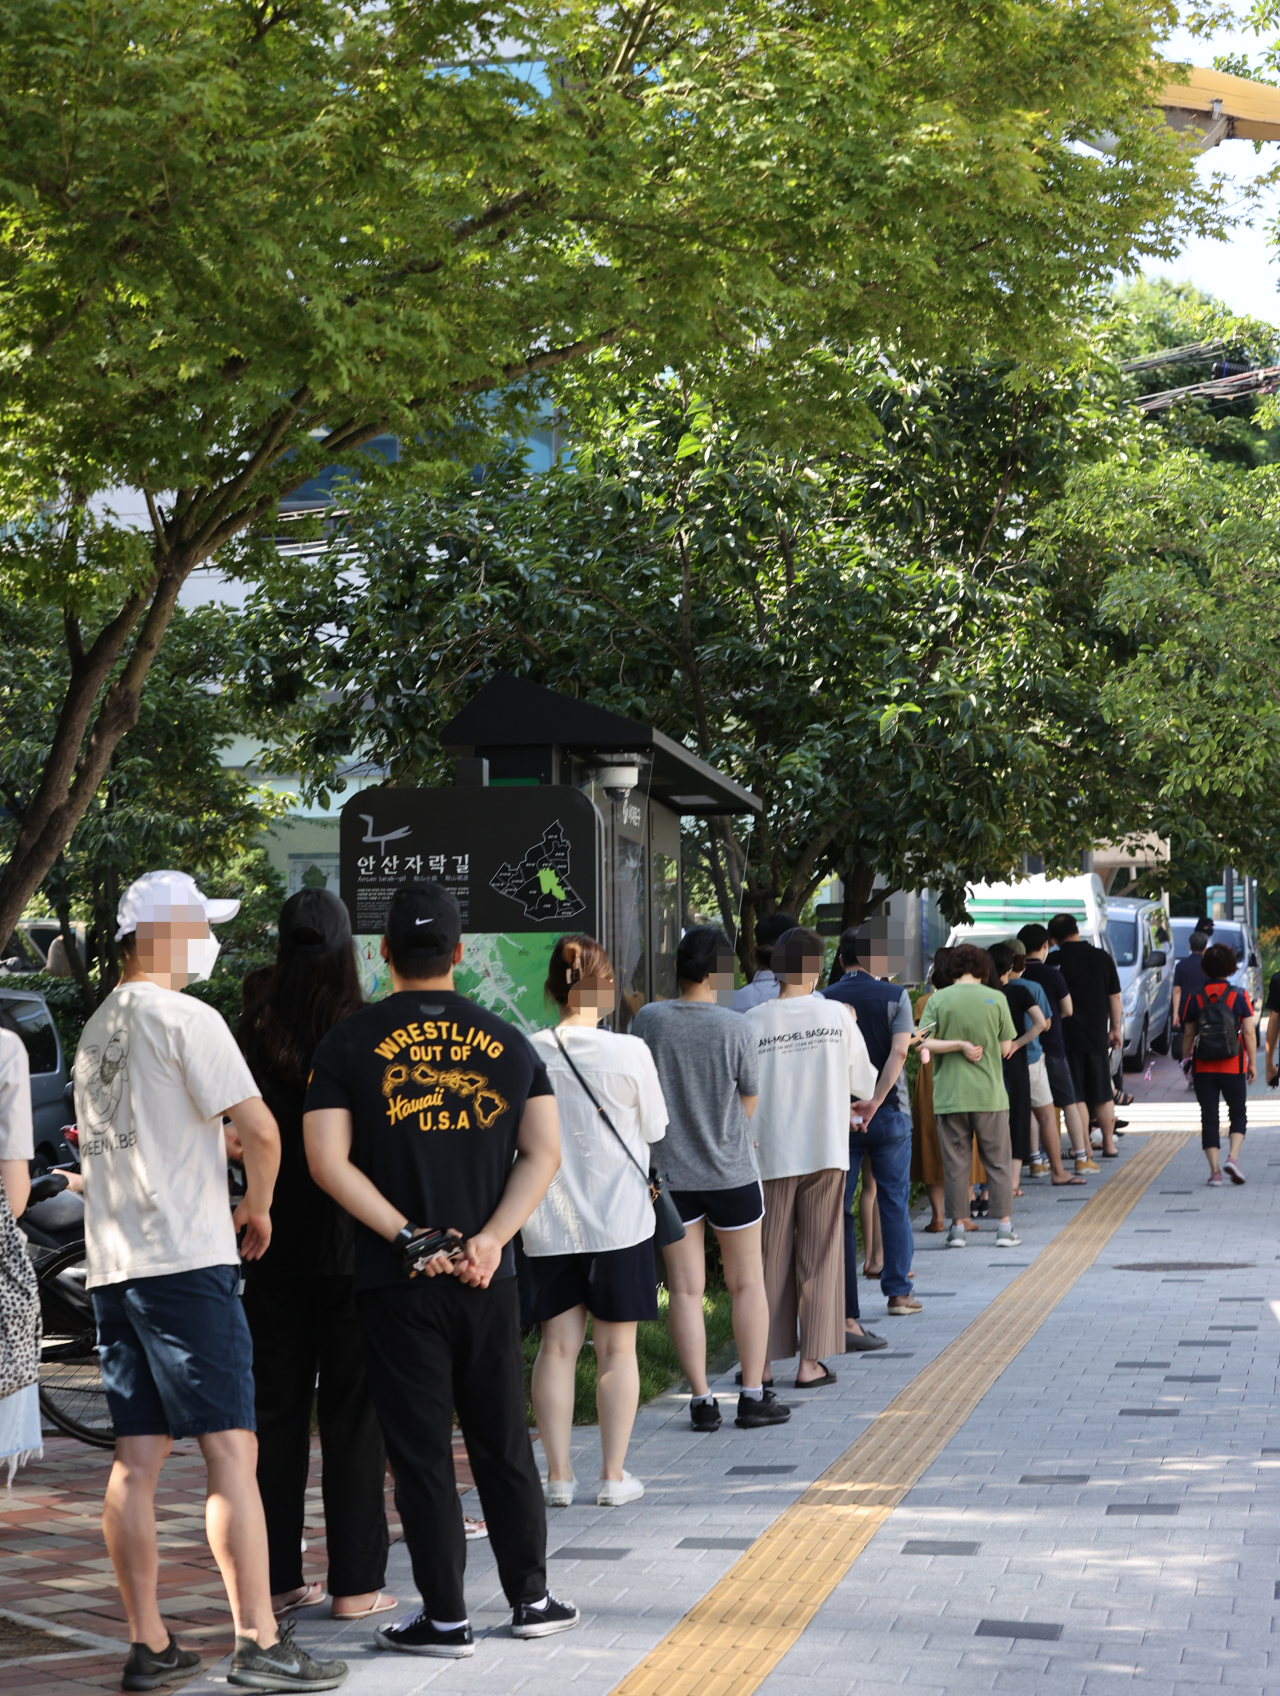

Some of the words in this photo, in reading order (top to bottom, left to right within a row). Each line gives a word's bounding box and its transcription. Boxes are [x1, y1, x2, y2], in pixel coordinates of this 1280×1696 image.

[357, 854, 470, 875] 안산자락길
[374, 1021, 504, 1060] WRESTLING
[410, 1045, 443, 1061] OUT
[450, 1045, 472, 1061] OF
[386, 1087, 445, 1126] Hawaii
[419, 1110, 470, 1131] U.S.A
